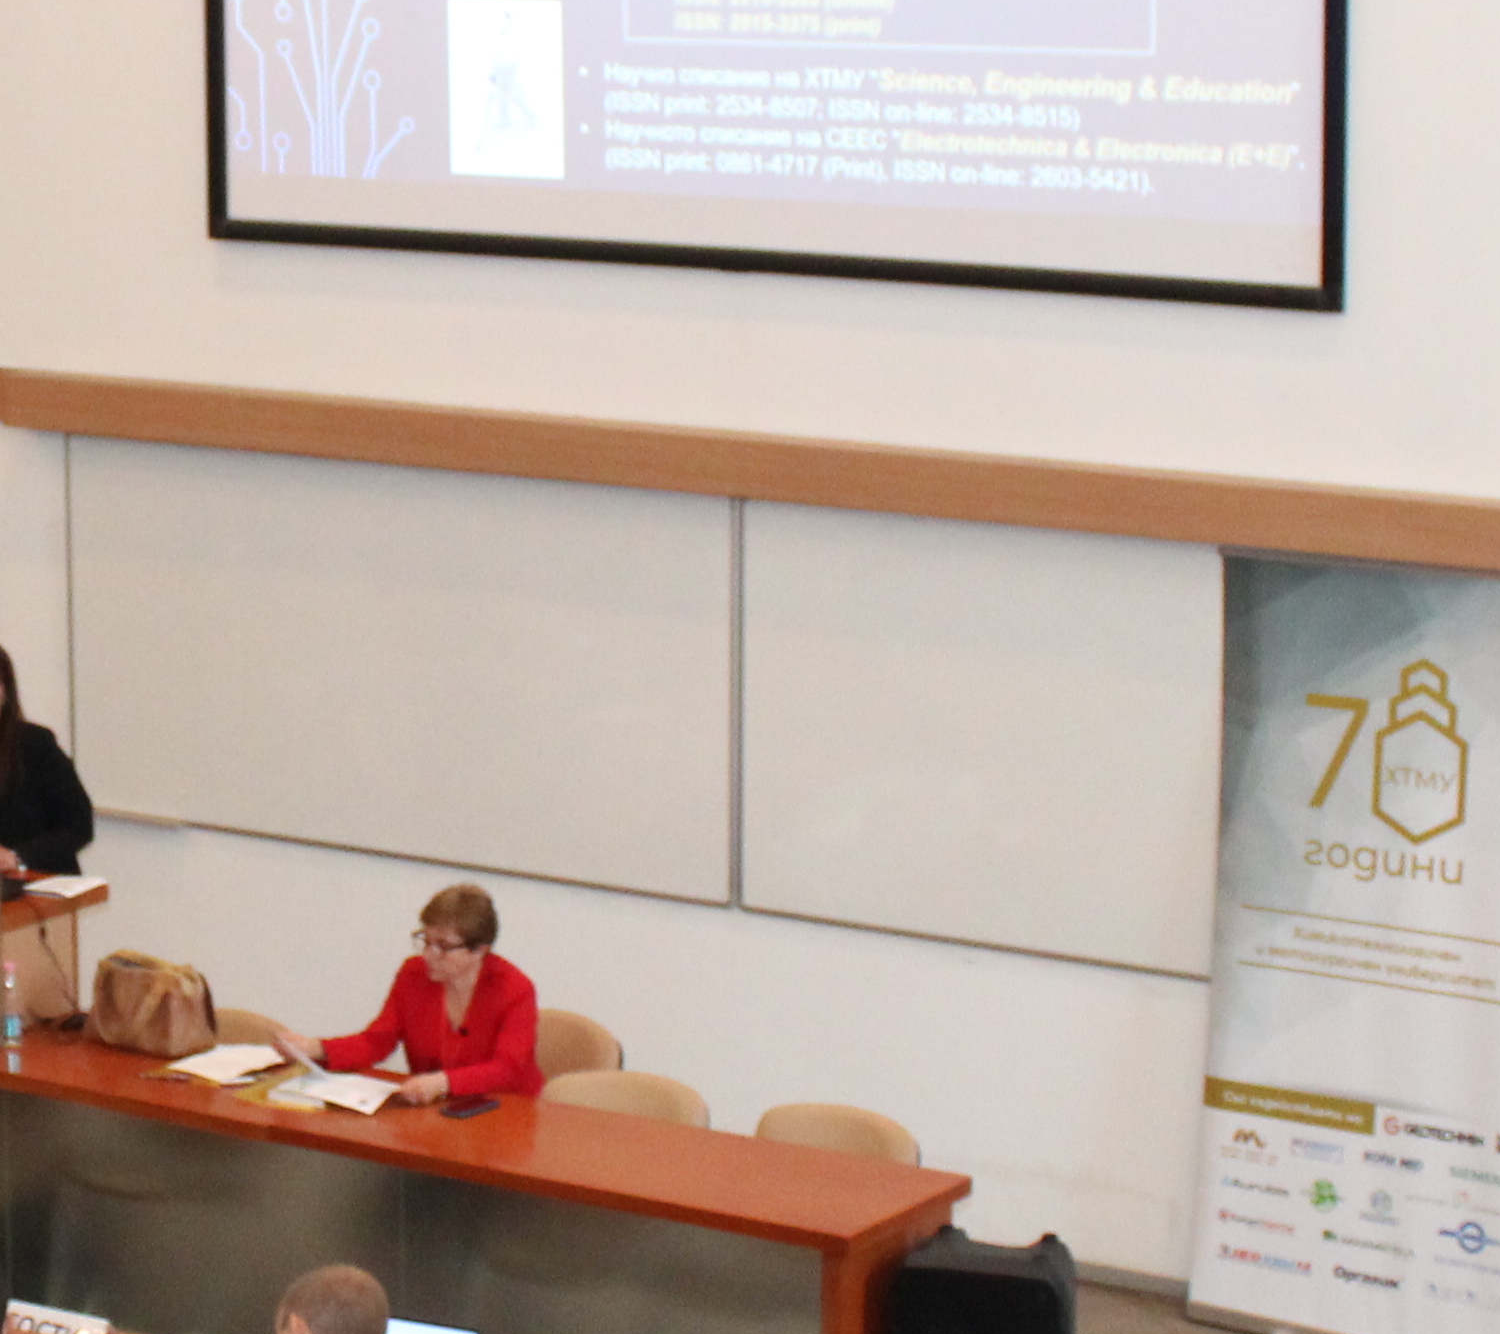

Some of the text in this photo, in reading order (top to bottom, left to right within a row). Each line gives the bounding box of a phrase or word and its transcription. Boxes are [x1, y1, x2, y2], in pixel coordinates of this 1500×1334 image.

[983, 69, 1133, 106] Engineering
[1384, 767, 1457, 792] ХТМУ
[1303, 839, 1464, 885] години
